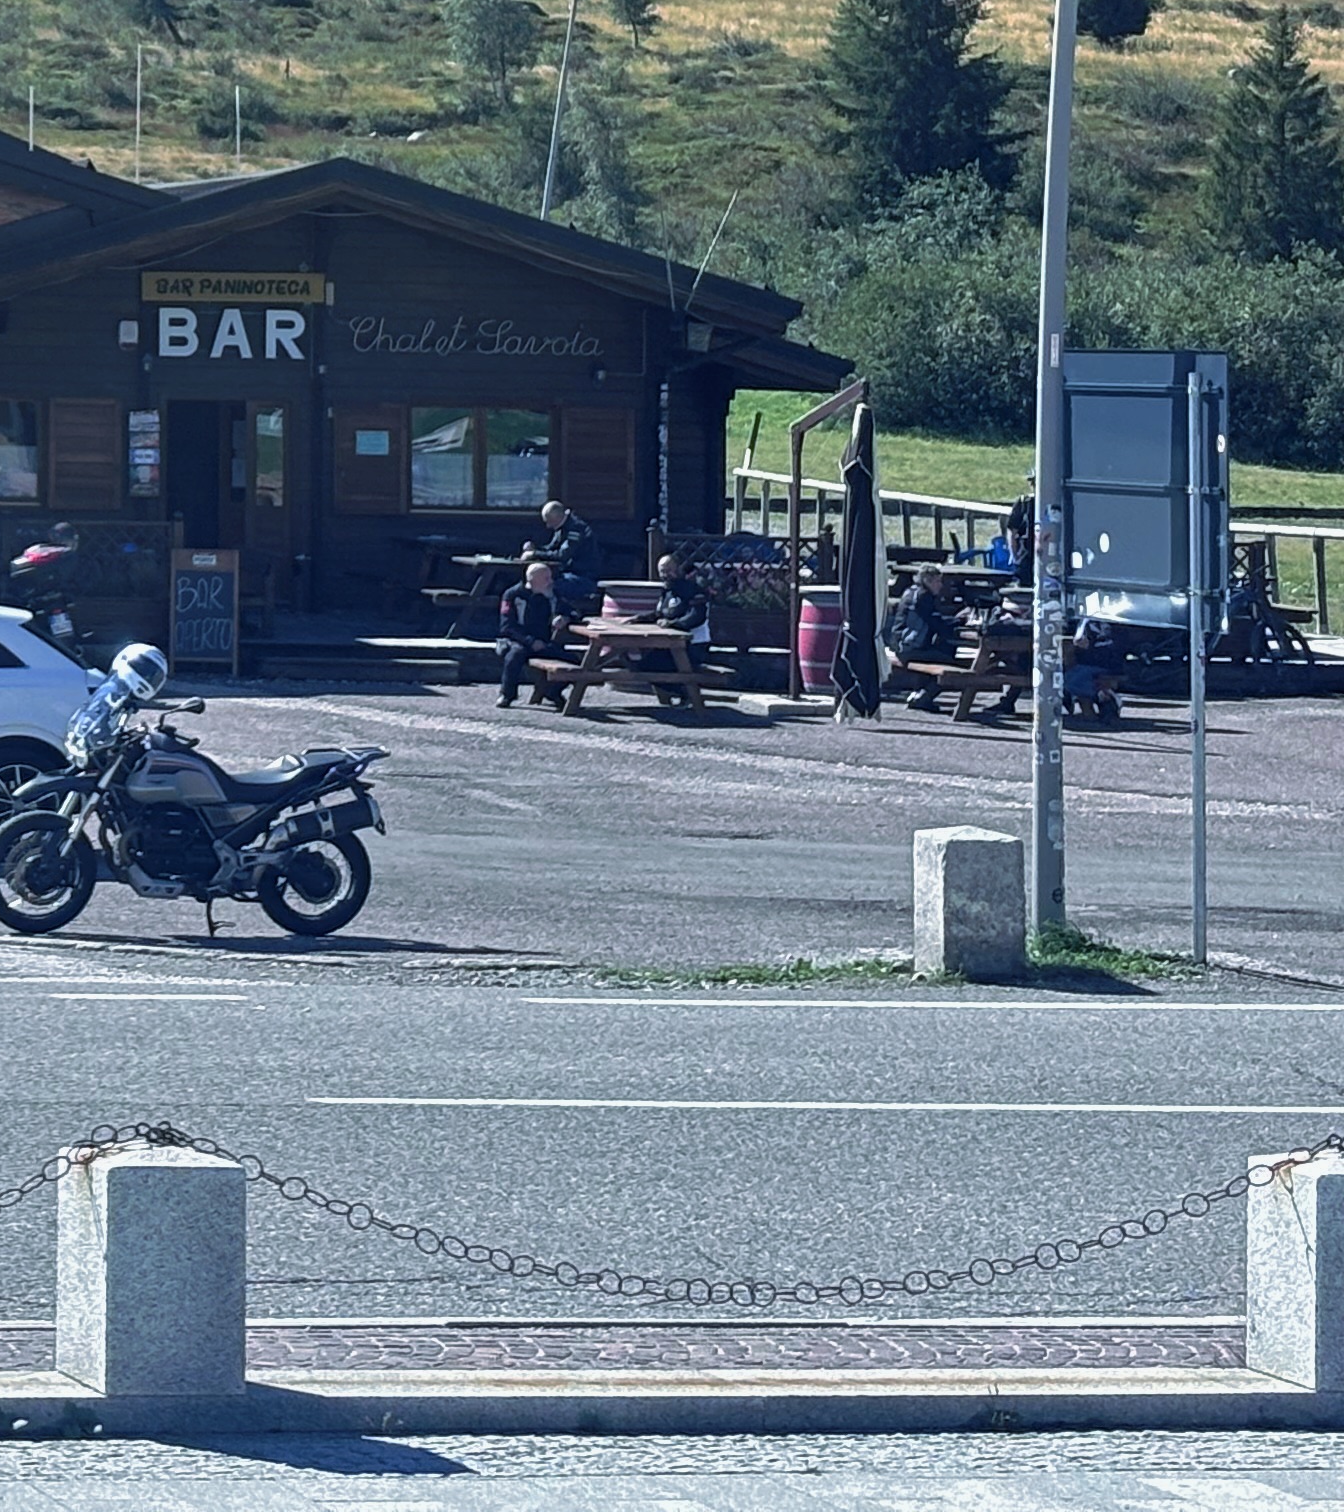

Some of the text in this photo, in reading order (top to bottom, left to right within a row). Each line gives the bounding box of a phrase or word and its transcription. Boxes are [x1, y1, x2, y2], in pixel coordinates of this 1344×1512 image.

[156, 277, 311, 297] BAR PANINOTECA
[159, 307, 306, 360] BAR
[349, 316, 605, 357] Chalet Savoia
[176, 575, 224, 612] BAR
[175, 617, 233, 652] APERTO
